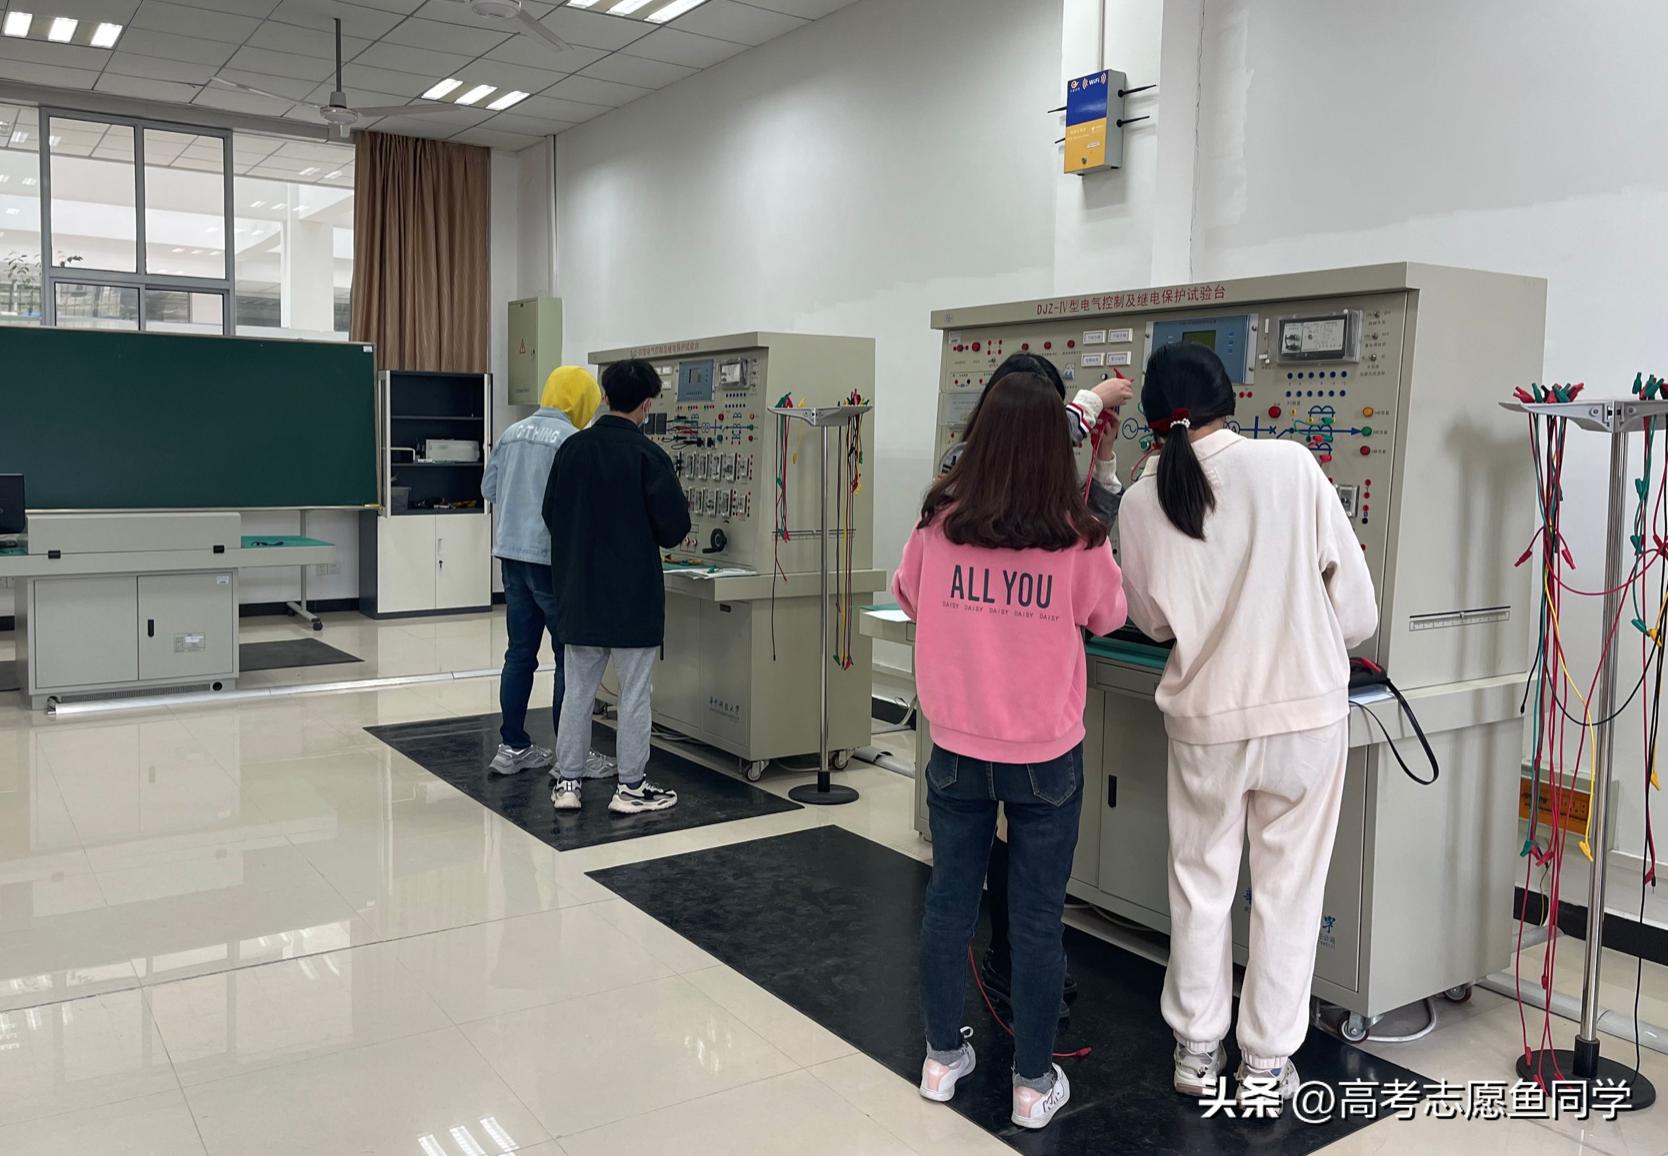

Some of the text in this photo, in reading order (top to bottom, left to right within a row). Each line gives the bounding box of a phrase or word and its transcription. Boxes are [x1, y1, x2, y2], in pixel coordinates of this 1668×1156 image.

[950, 564, 1053, 609] ALL YOU
[942, 600, 1060, 622] DAISY DAISY DAISY DAISY DAISY
